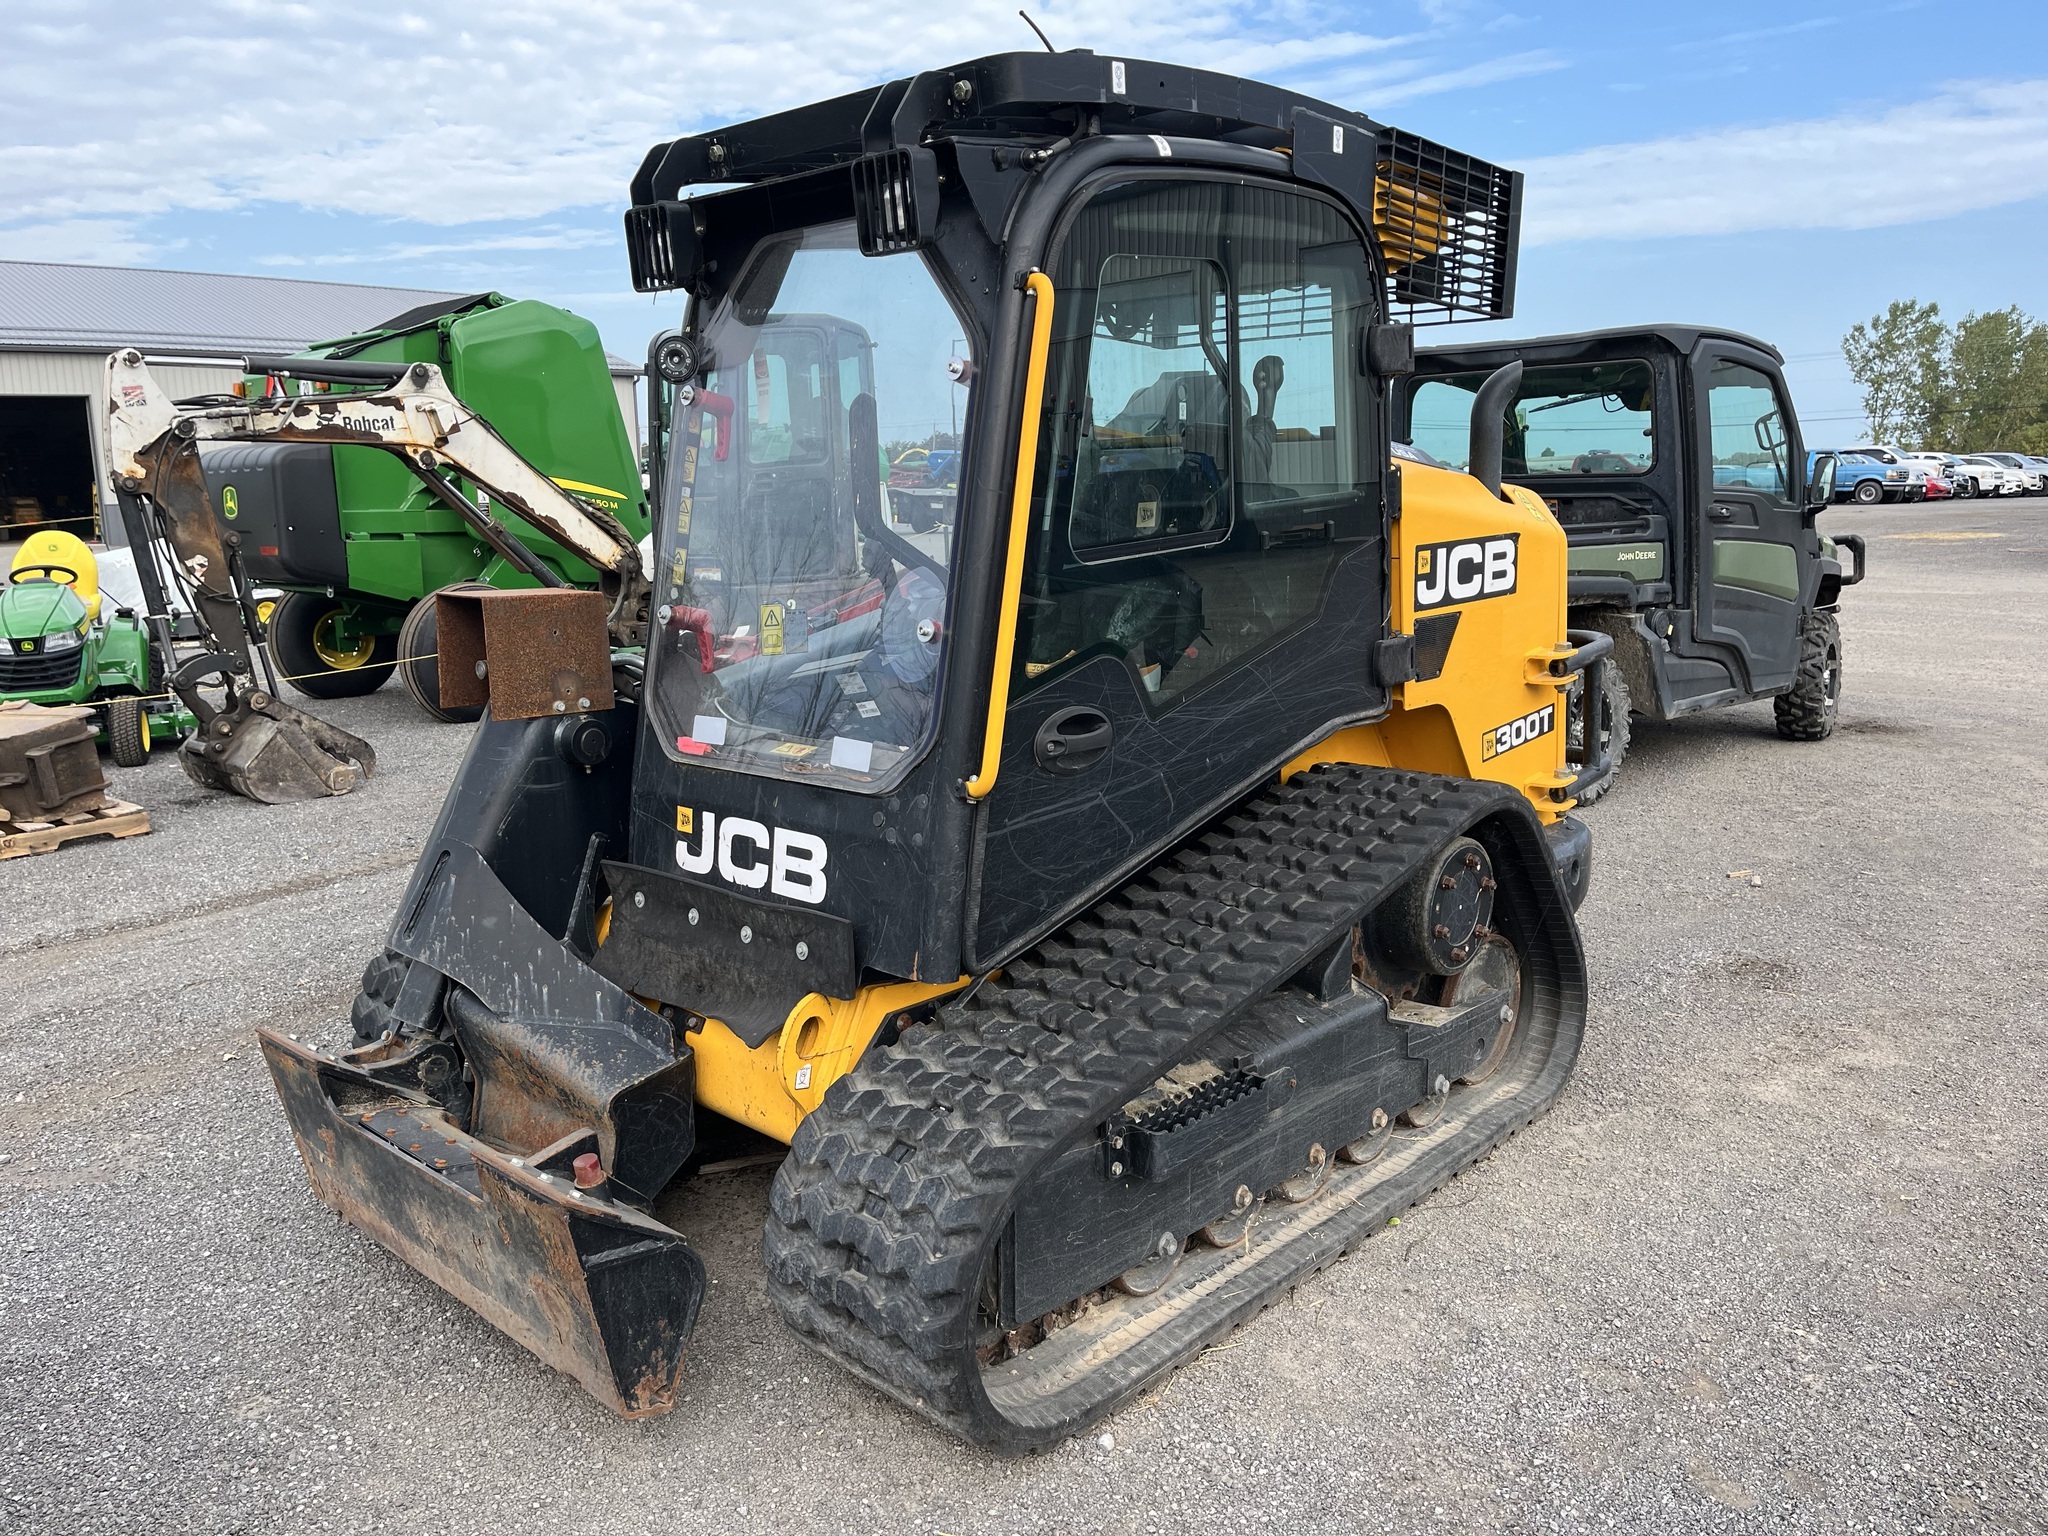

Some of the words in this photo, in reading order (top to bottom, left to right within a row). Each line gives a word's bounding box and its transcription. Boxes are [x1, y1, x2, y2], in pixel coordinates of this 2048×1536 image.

[342, 415, 396, 432] Bobcat
[1417, 539, 1516, 605] JCB
[1617, 551, 1635, 561] JOHN
[1635, 551, 1657, 560] DEERE
[1496, 705, 1554, 753] 300T
[675, 810, 828, 904] JCB
